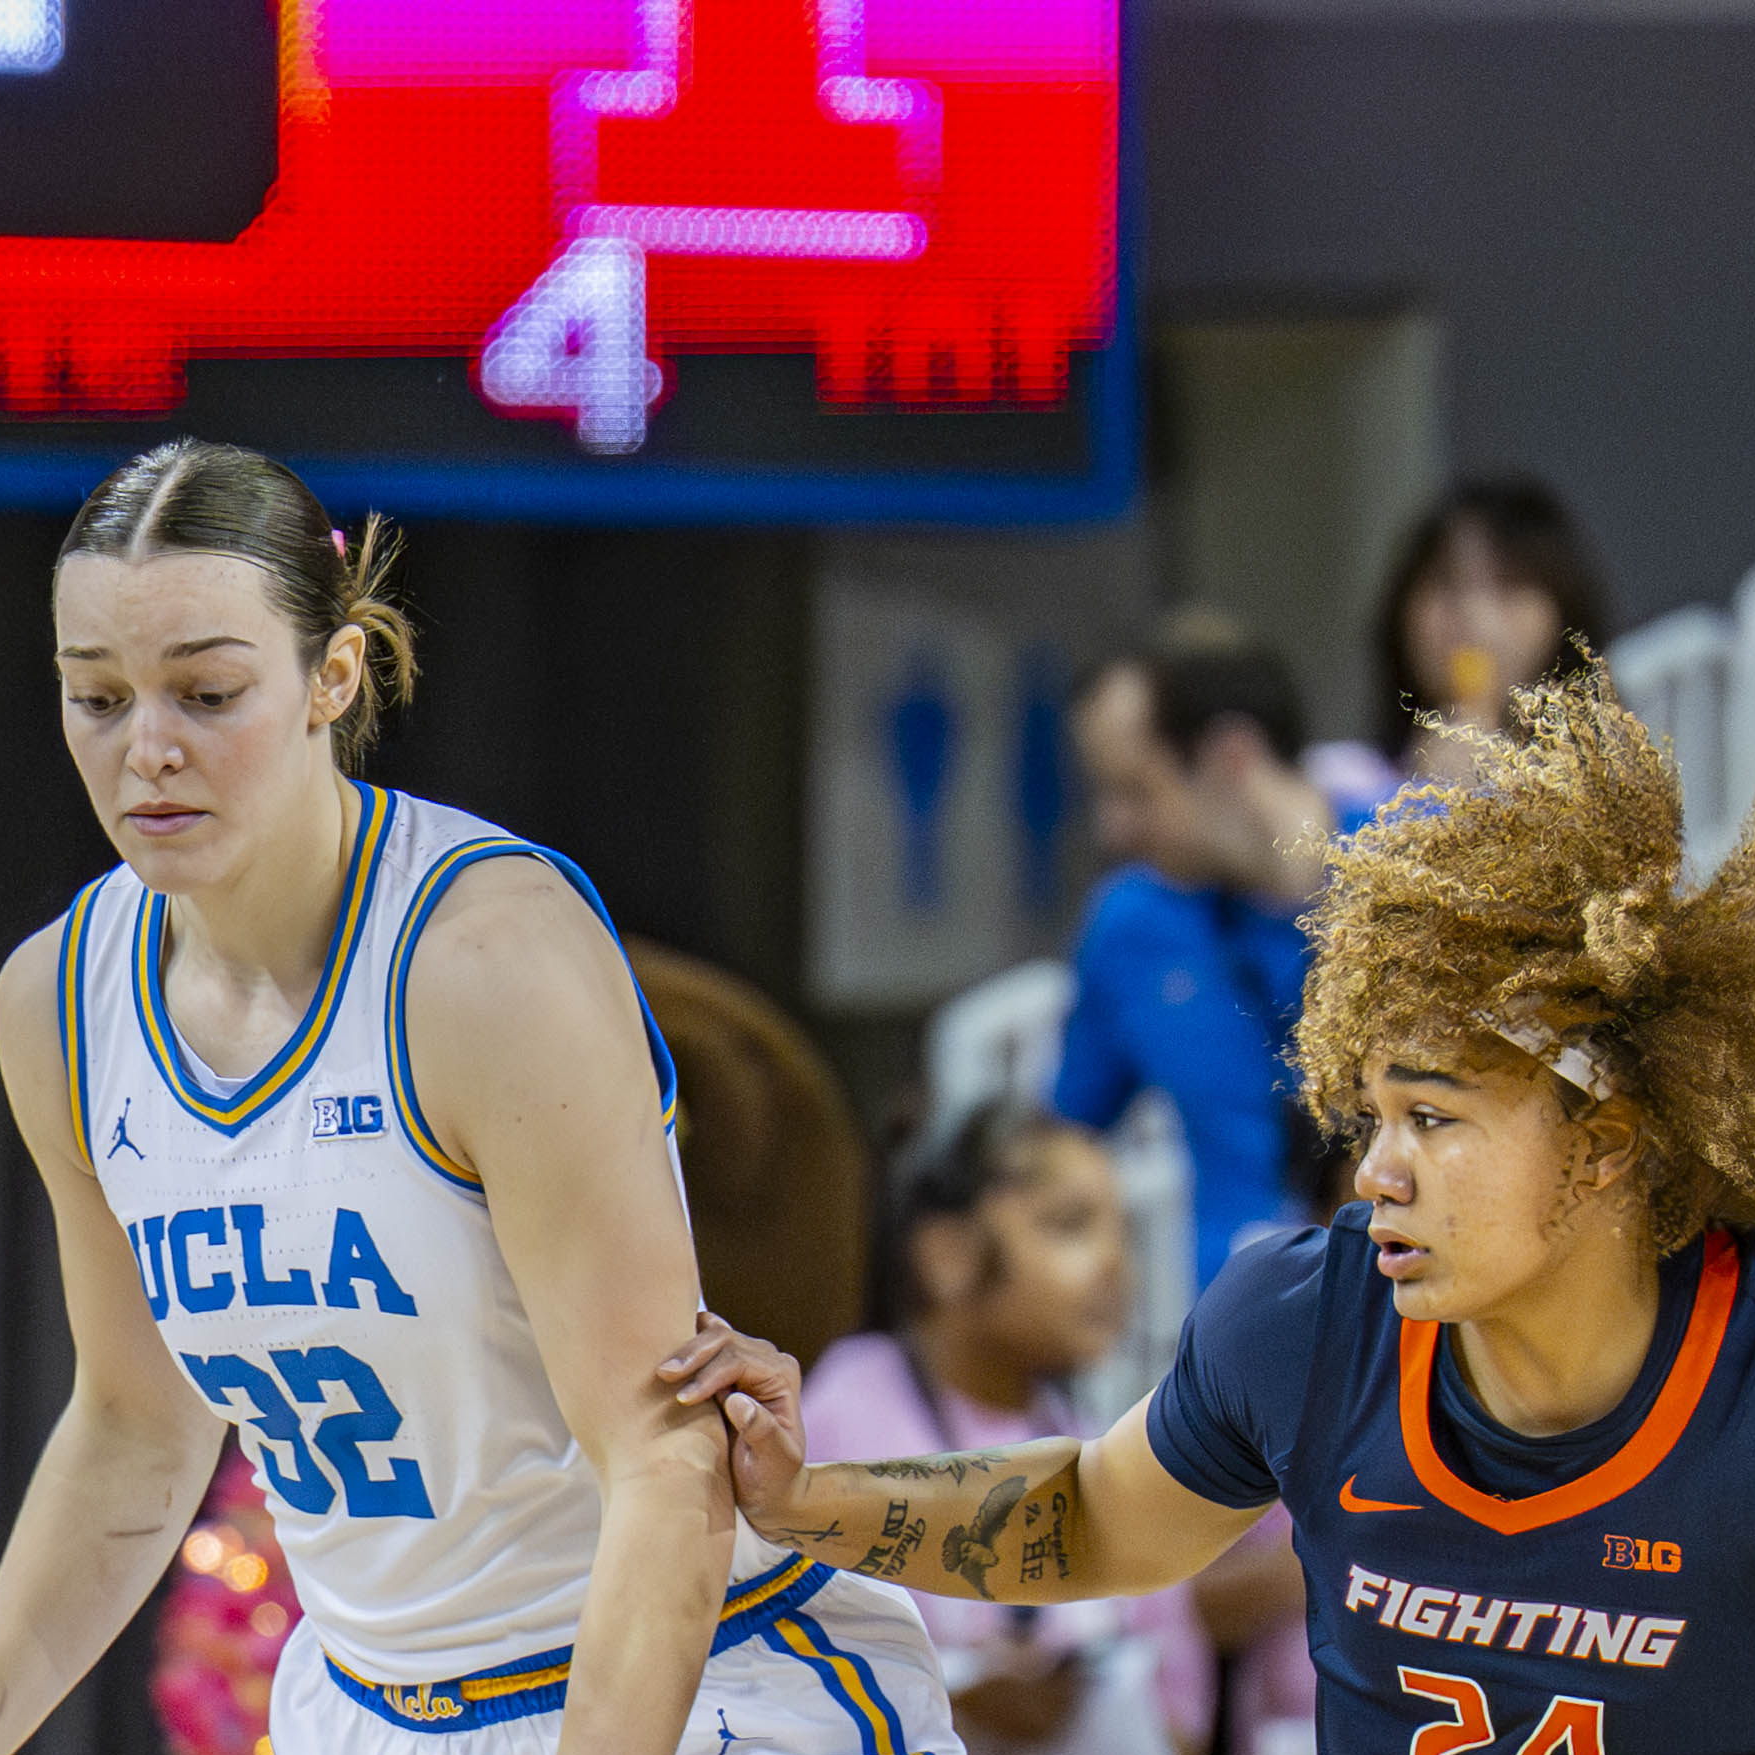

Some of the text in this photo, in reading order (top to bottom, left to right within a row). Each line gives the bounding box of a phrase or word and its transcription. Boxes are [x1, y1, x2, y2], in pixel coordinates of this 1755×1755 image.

[480, 236, 665, 456] 4
[127, 1203, 420, 1322] UCLA
[178, 1345, 437, 1520] 32
[1345, 1563, 1687, 1669] FIGHTING
